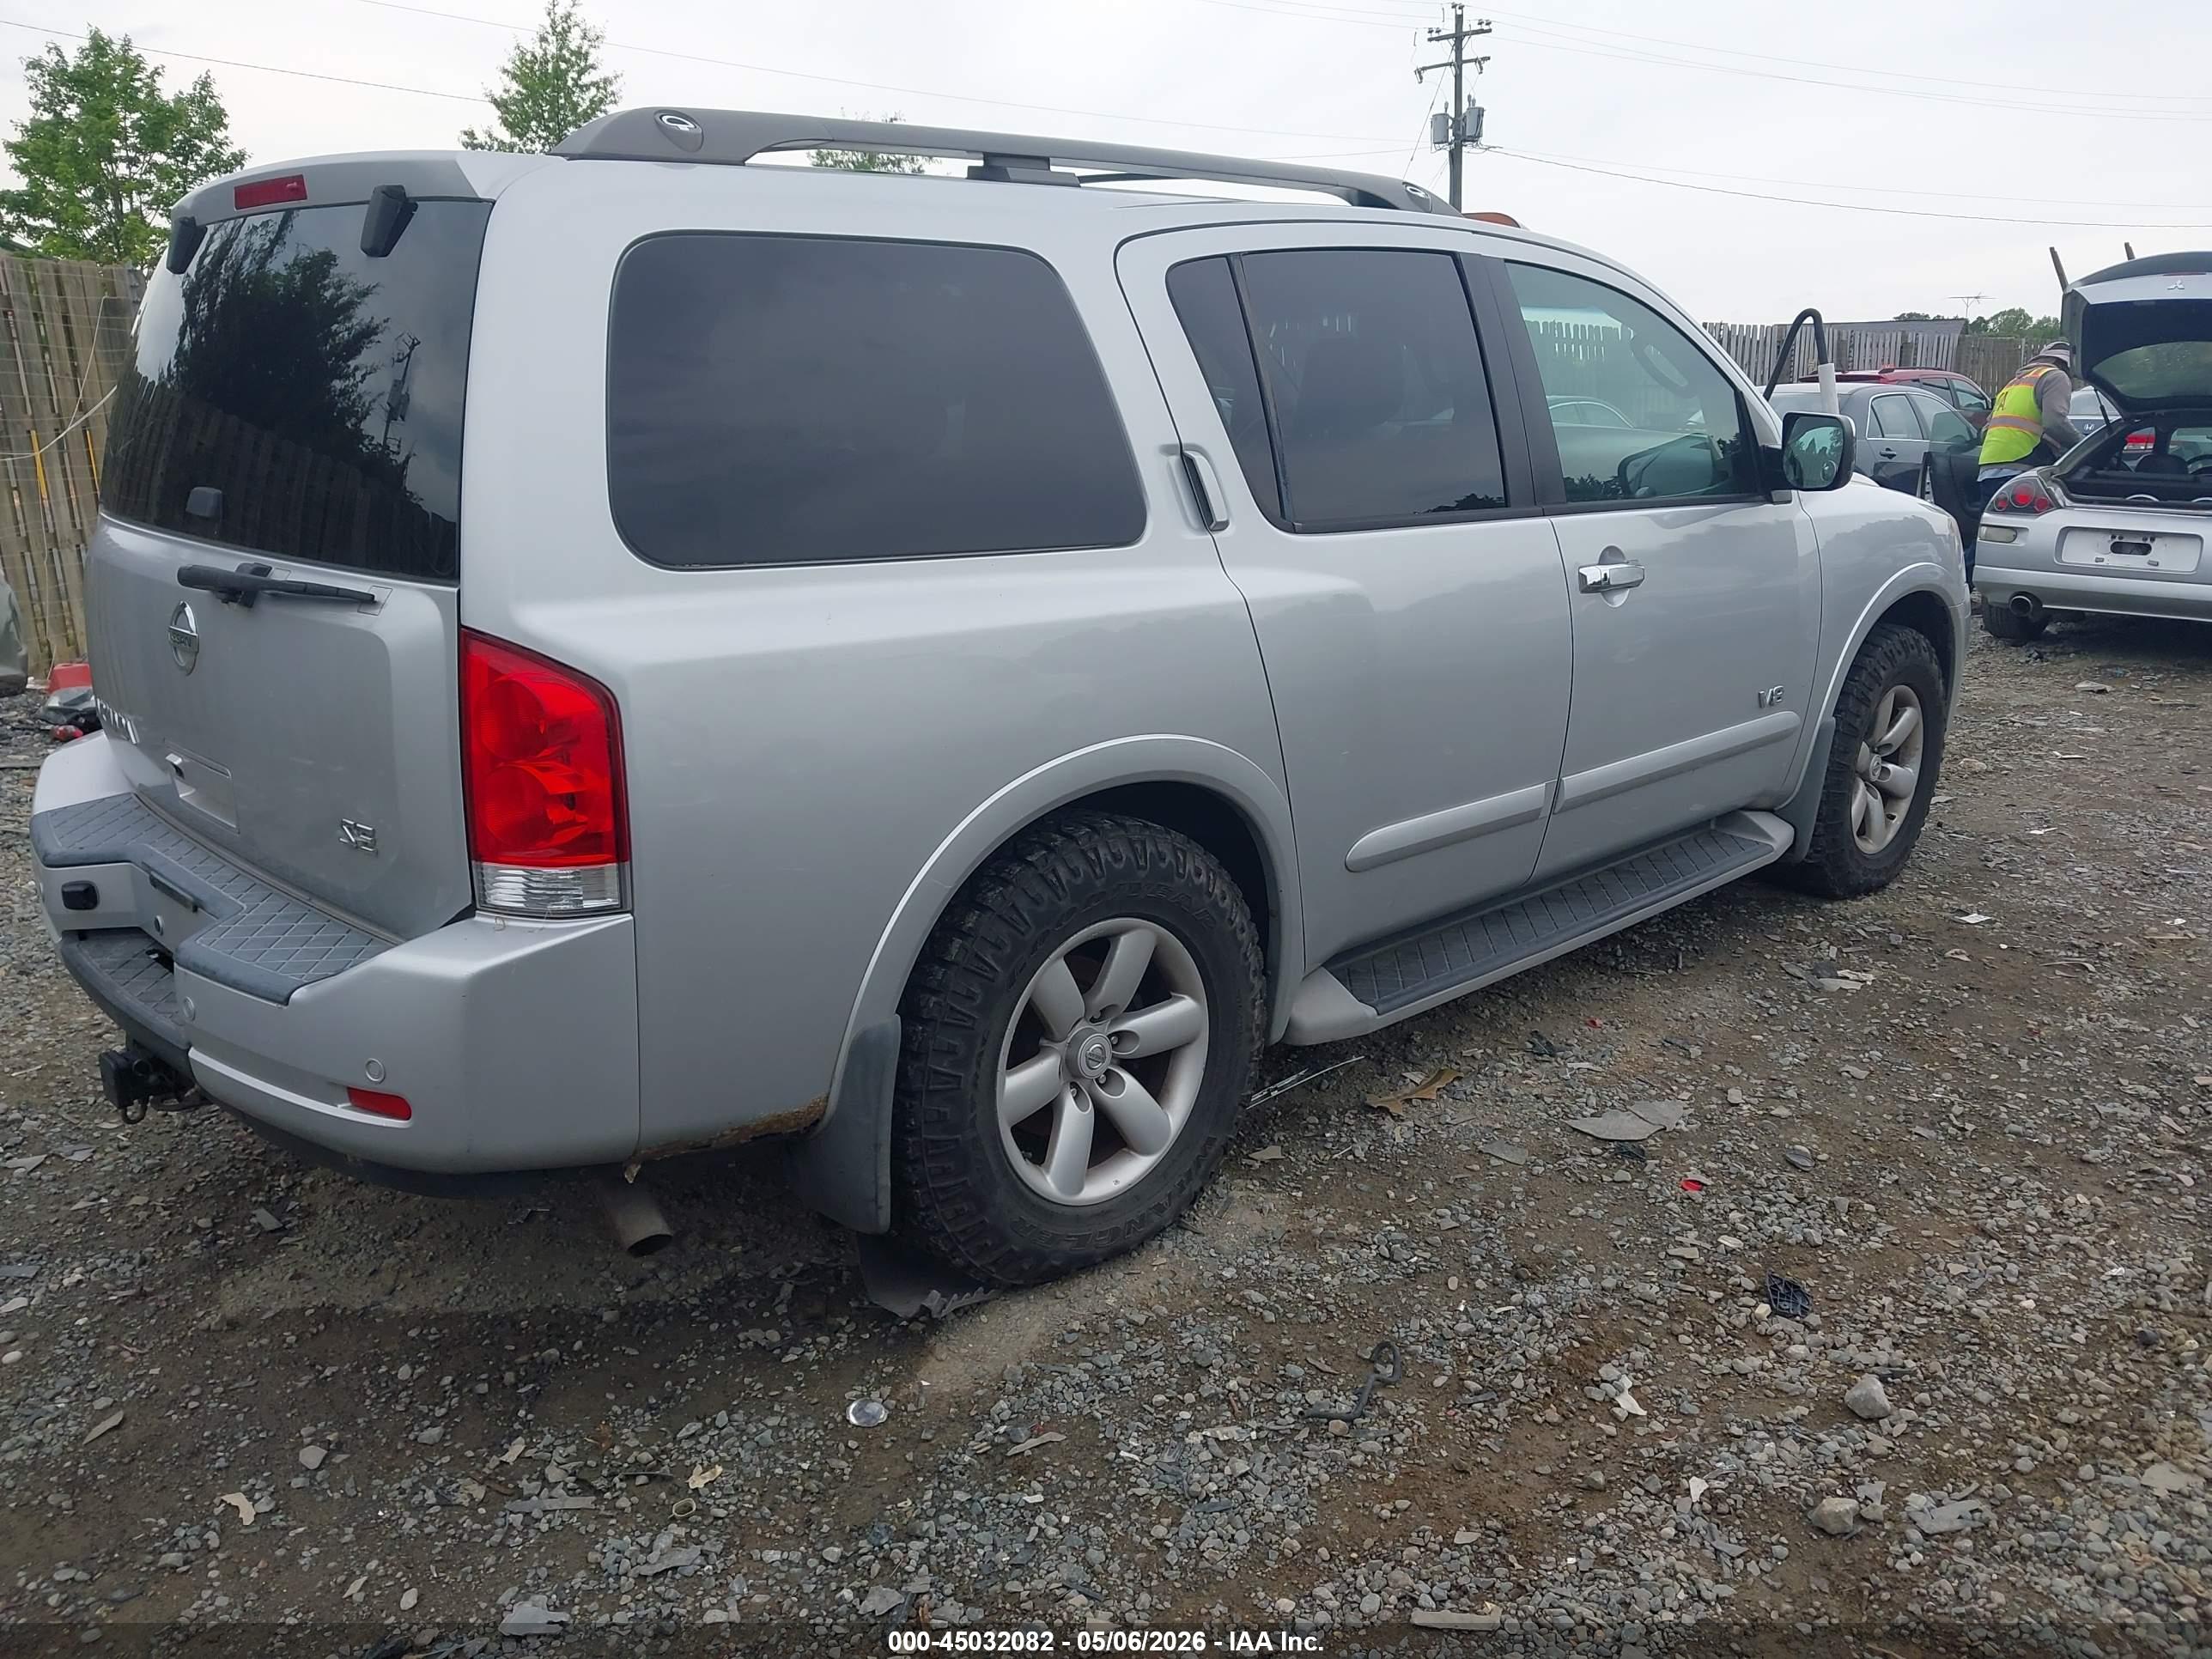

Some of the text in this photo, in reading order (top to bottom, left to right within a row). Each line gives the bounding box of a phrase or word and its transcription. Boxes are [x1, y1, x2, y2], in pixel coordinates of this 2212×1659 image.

[1758, 684, 1784, 708] V8
[338, 817, 378, 853] SE
[1008, 1133, 1219, 1252] WRANGLER
